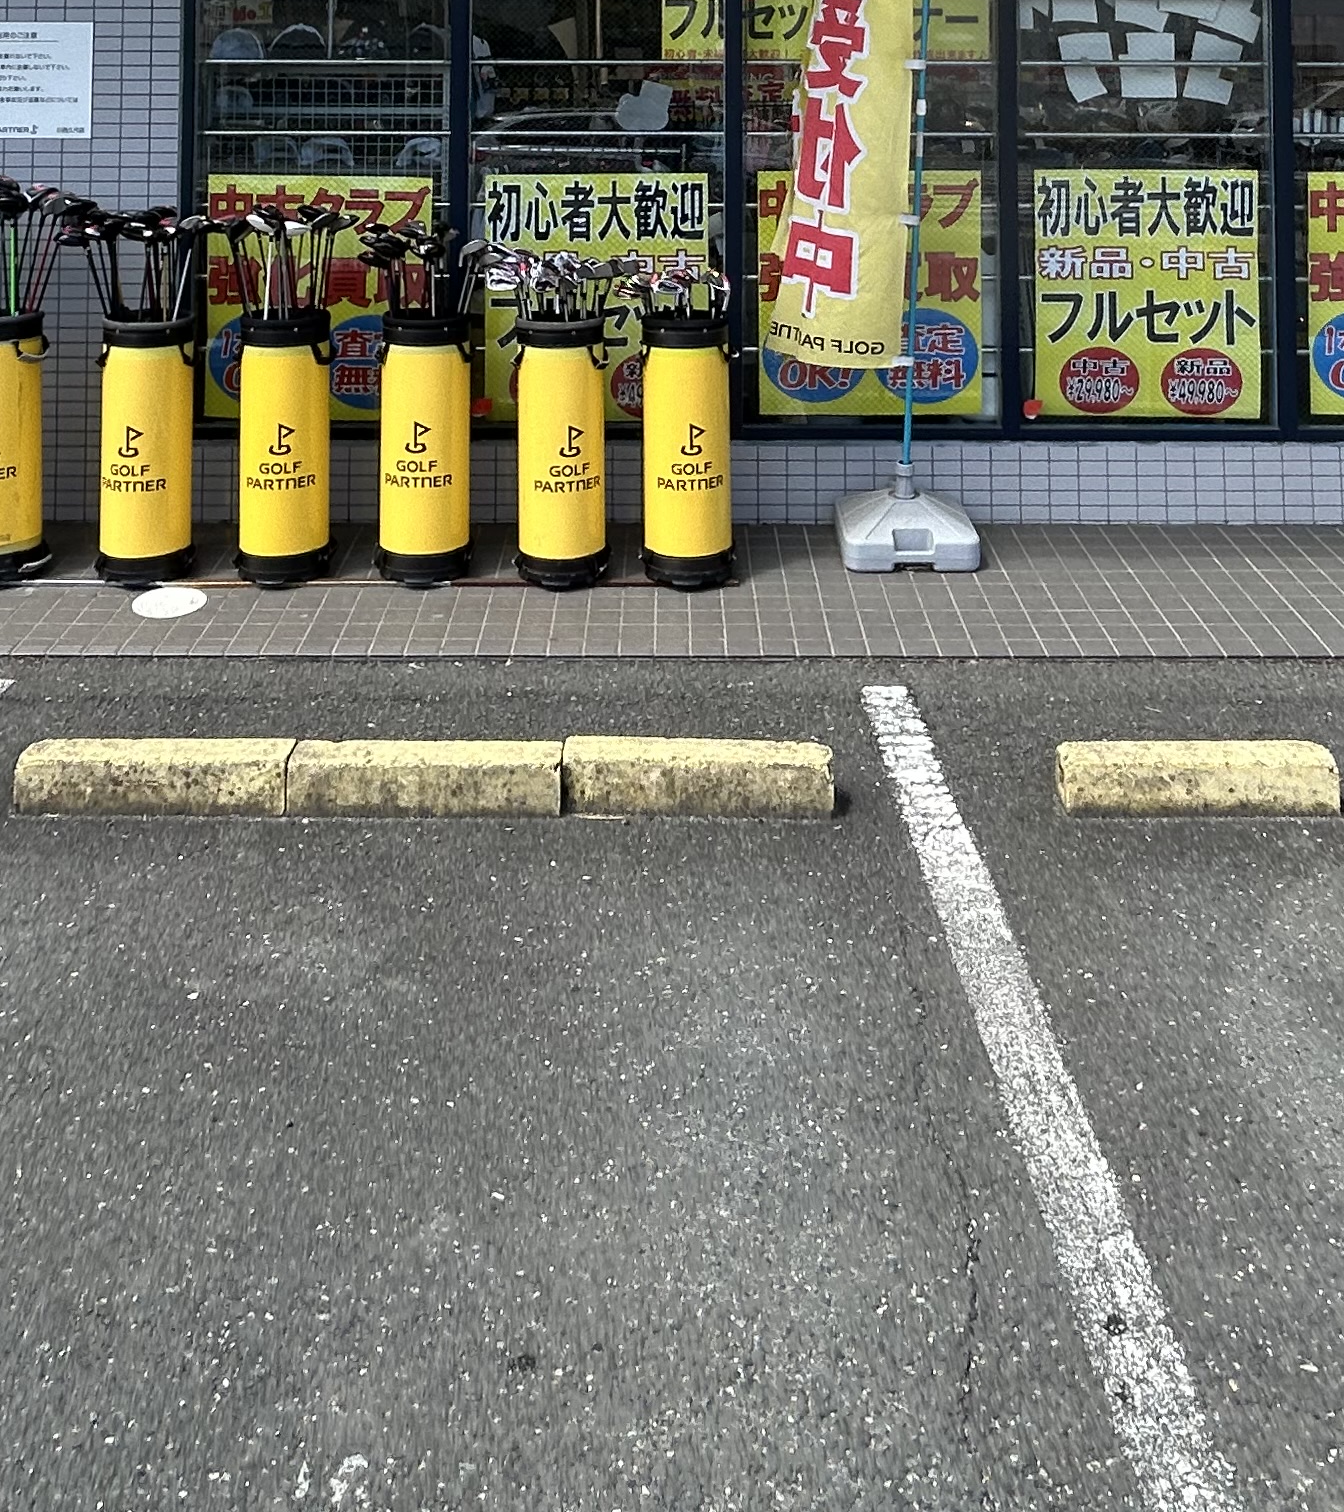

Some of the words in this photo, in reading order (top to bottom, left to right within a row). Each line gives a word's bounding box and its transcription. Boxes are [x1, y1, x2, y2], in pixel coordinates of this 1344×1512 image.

[487, 180, 705, 242] 初心者大歓迎
[759, 178, 980, 229] 中ラブ
[1036, 175, 1255, 238] 初心者大歓迎
[1038, 245, 1255, 281] 新品・中古
[1041, 289, 1257, 346] フルセット
[335, 329, 383, 359] 査
[779, 359, 852, 391] OK!
[1070, 357, 1130, 376] 中古
[1174, 357, 1233, 377] 新品
[110, 464, 151, 477] GOLF
[259, 461, 303, 475] GOLF
[396, 460, 438, 473] GOLF
[549, 462, 591, 478] GOLF
[671, 461, 713, 477] GOLF
[246, 474, 317, 491] PARTNER
[384, 474, 453, 489] PARTNER
[534, 475, 601, 494] PARTNER
[657, 474, 725, 492] PARTNER
